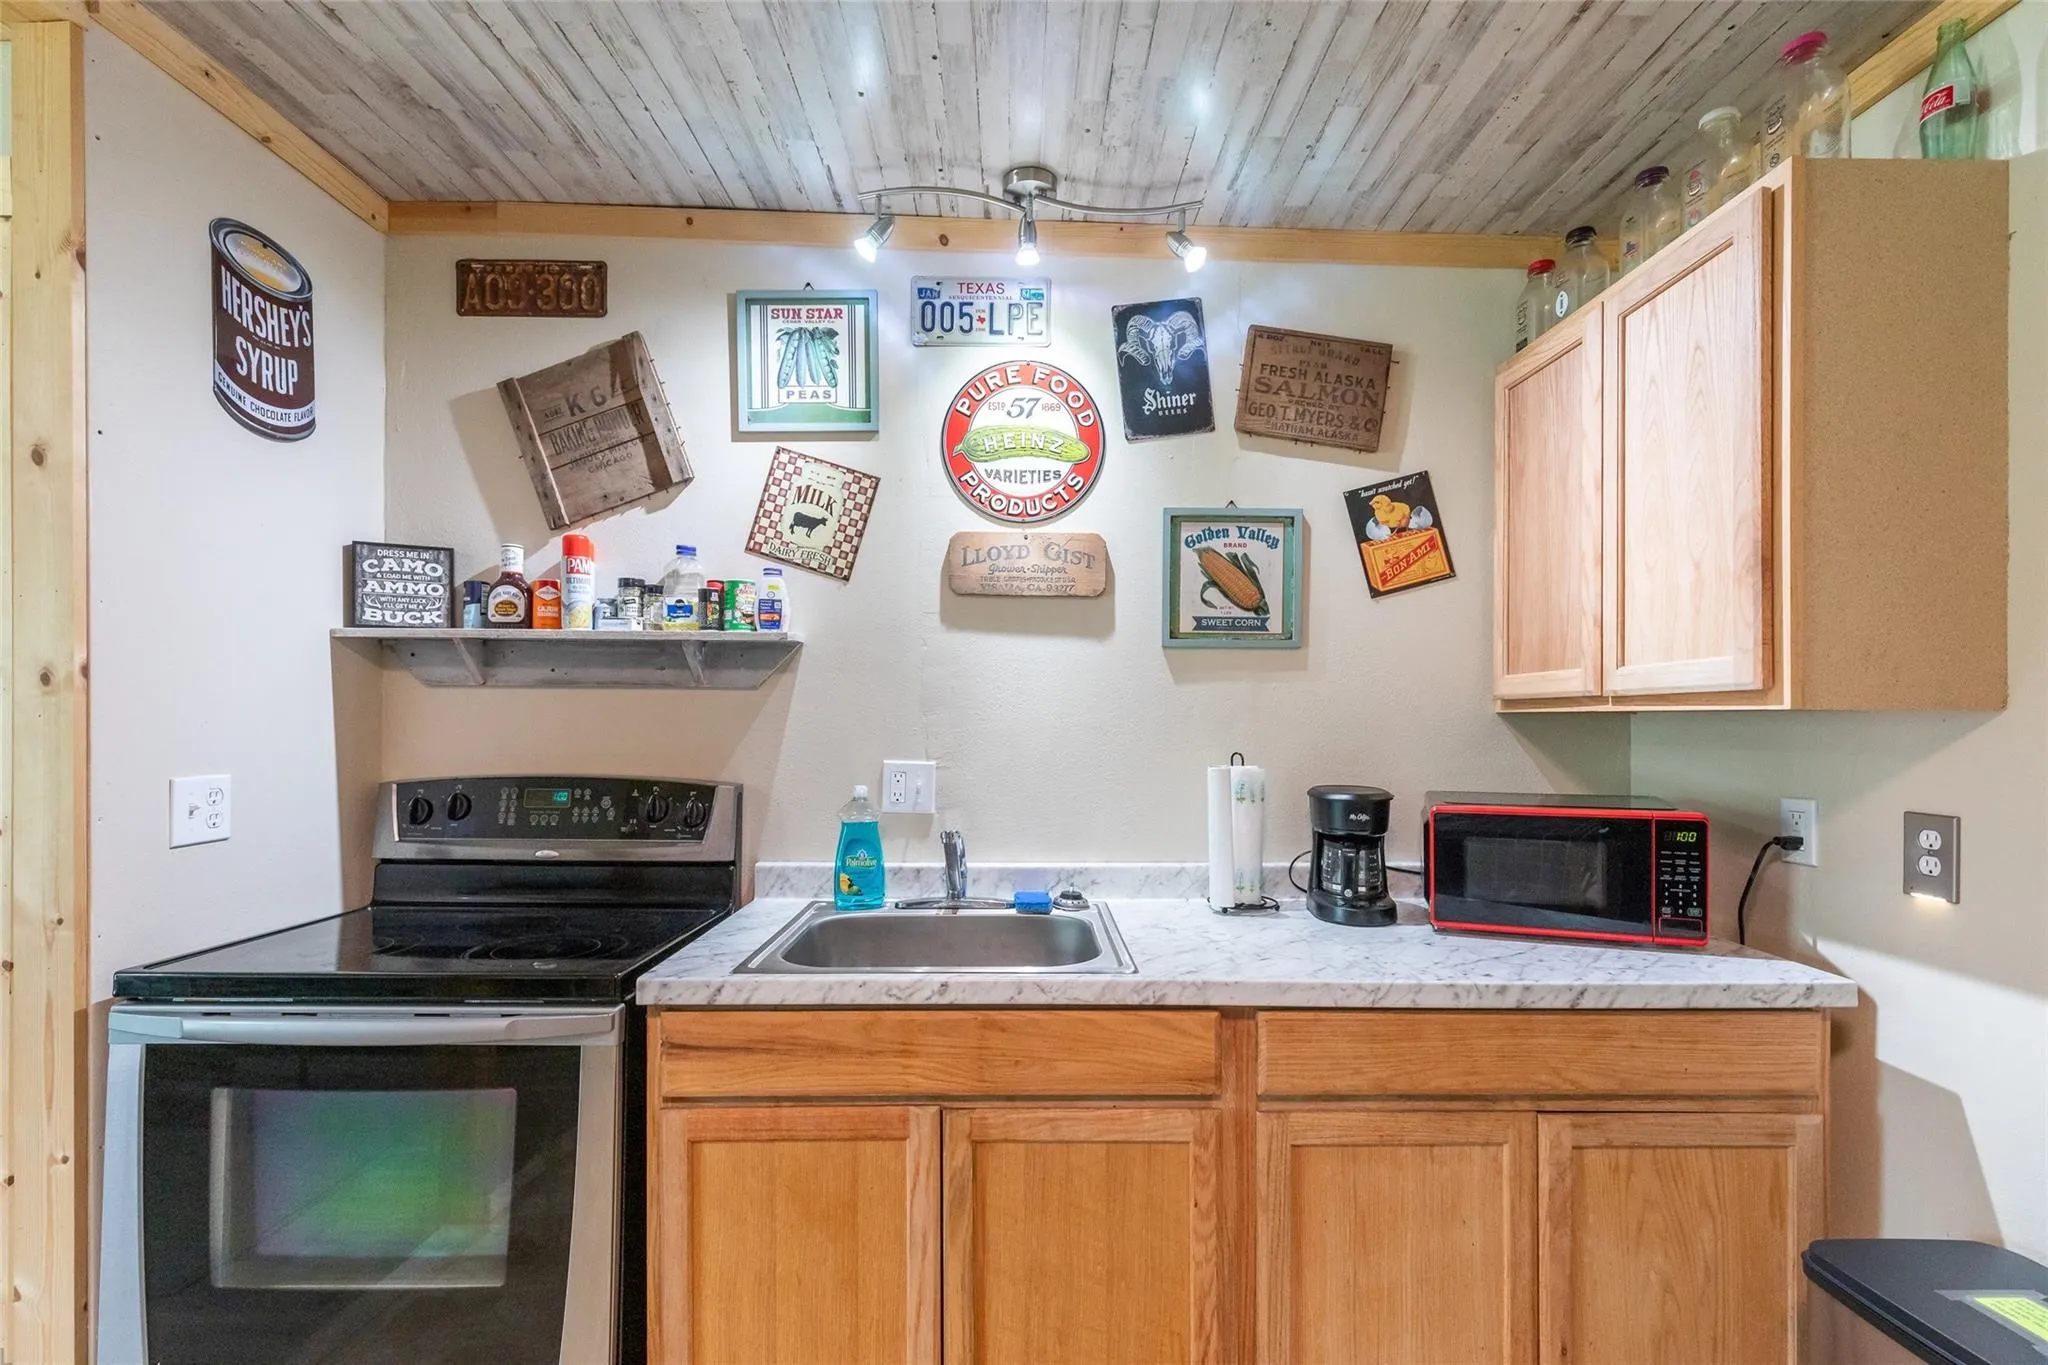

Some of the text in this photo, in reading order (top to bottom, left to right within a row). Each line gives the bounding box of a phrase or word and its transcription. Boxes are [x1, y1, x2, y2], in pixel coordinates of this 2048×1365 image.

[920, 289, 939, 298] JAN
[957, 283, 1005, 294] TEXAS
[221, 265, 312, 348] HERSHEY'S
[771, 308, 843, 319] SUN STAR
[921, 301, 1043, 336] 005 LPE
[235, 335, 298, 396] SYRUP
[1260, 363, 1376, 390] FRESH ALASKA
[218, 371, 247, 407] GENUINE
[250, 401, 292, 422] CHOCOLATE
[786, 390, 832, 399] PEAS
[955, 366, 1095, 427] PURE FOOD
[1142, 387, 1197, 415] Shiner
[1254, 376, 1380, 408] SALMON
[566, 393, 586, 418] K
[1007, 397, 1041, 419] 57
[595, 402, 646, 434] POWDR
[983, 431, 1064, 454] HEINZ
[588, 453, 633, 474] CHICAGO
[984, 468, 1062, 485] VARIETIES
[792, 484, 837, 516] MILK
[960, 471, 1085, 516] PRODUCTS
[1184, 525, 1280, 550] Golden Valley
[377, 549, 430, 560] DRESS ME IN
[769, 541, 833, 566] DAIRY FRESH
[961, 541, 1096, 570] LLOYD GIST
[362, 557, 444, 577] CAMO
[567, 557, 592, 574] PAM
[362, 580, 444, 596] AMMO
[362, 608, 443, 623] BUCK
[1201, 618, 1261, 627] SWEET CORN
[1677, 831, 1697, 842] 1:00
[846, 857, 876, 867] Palmolive
